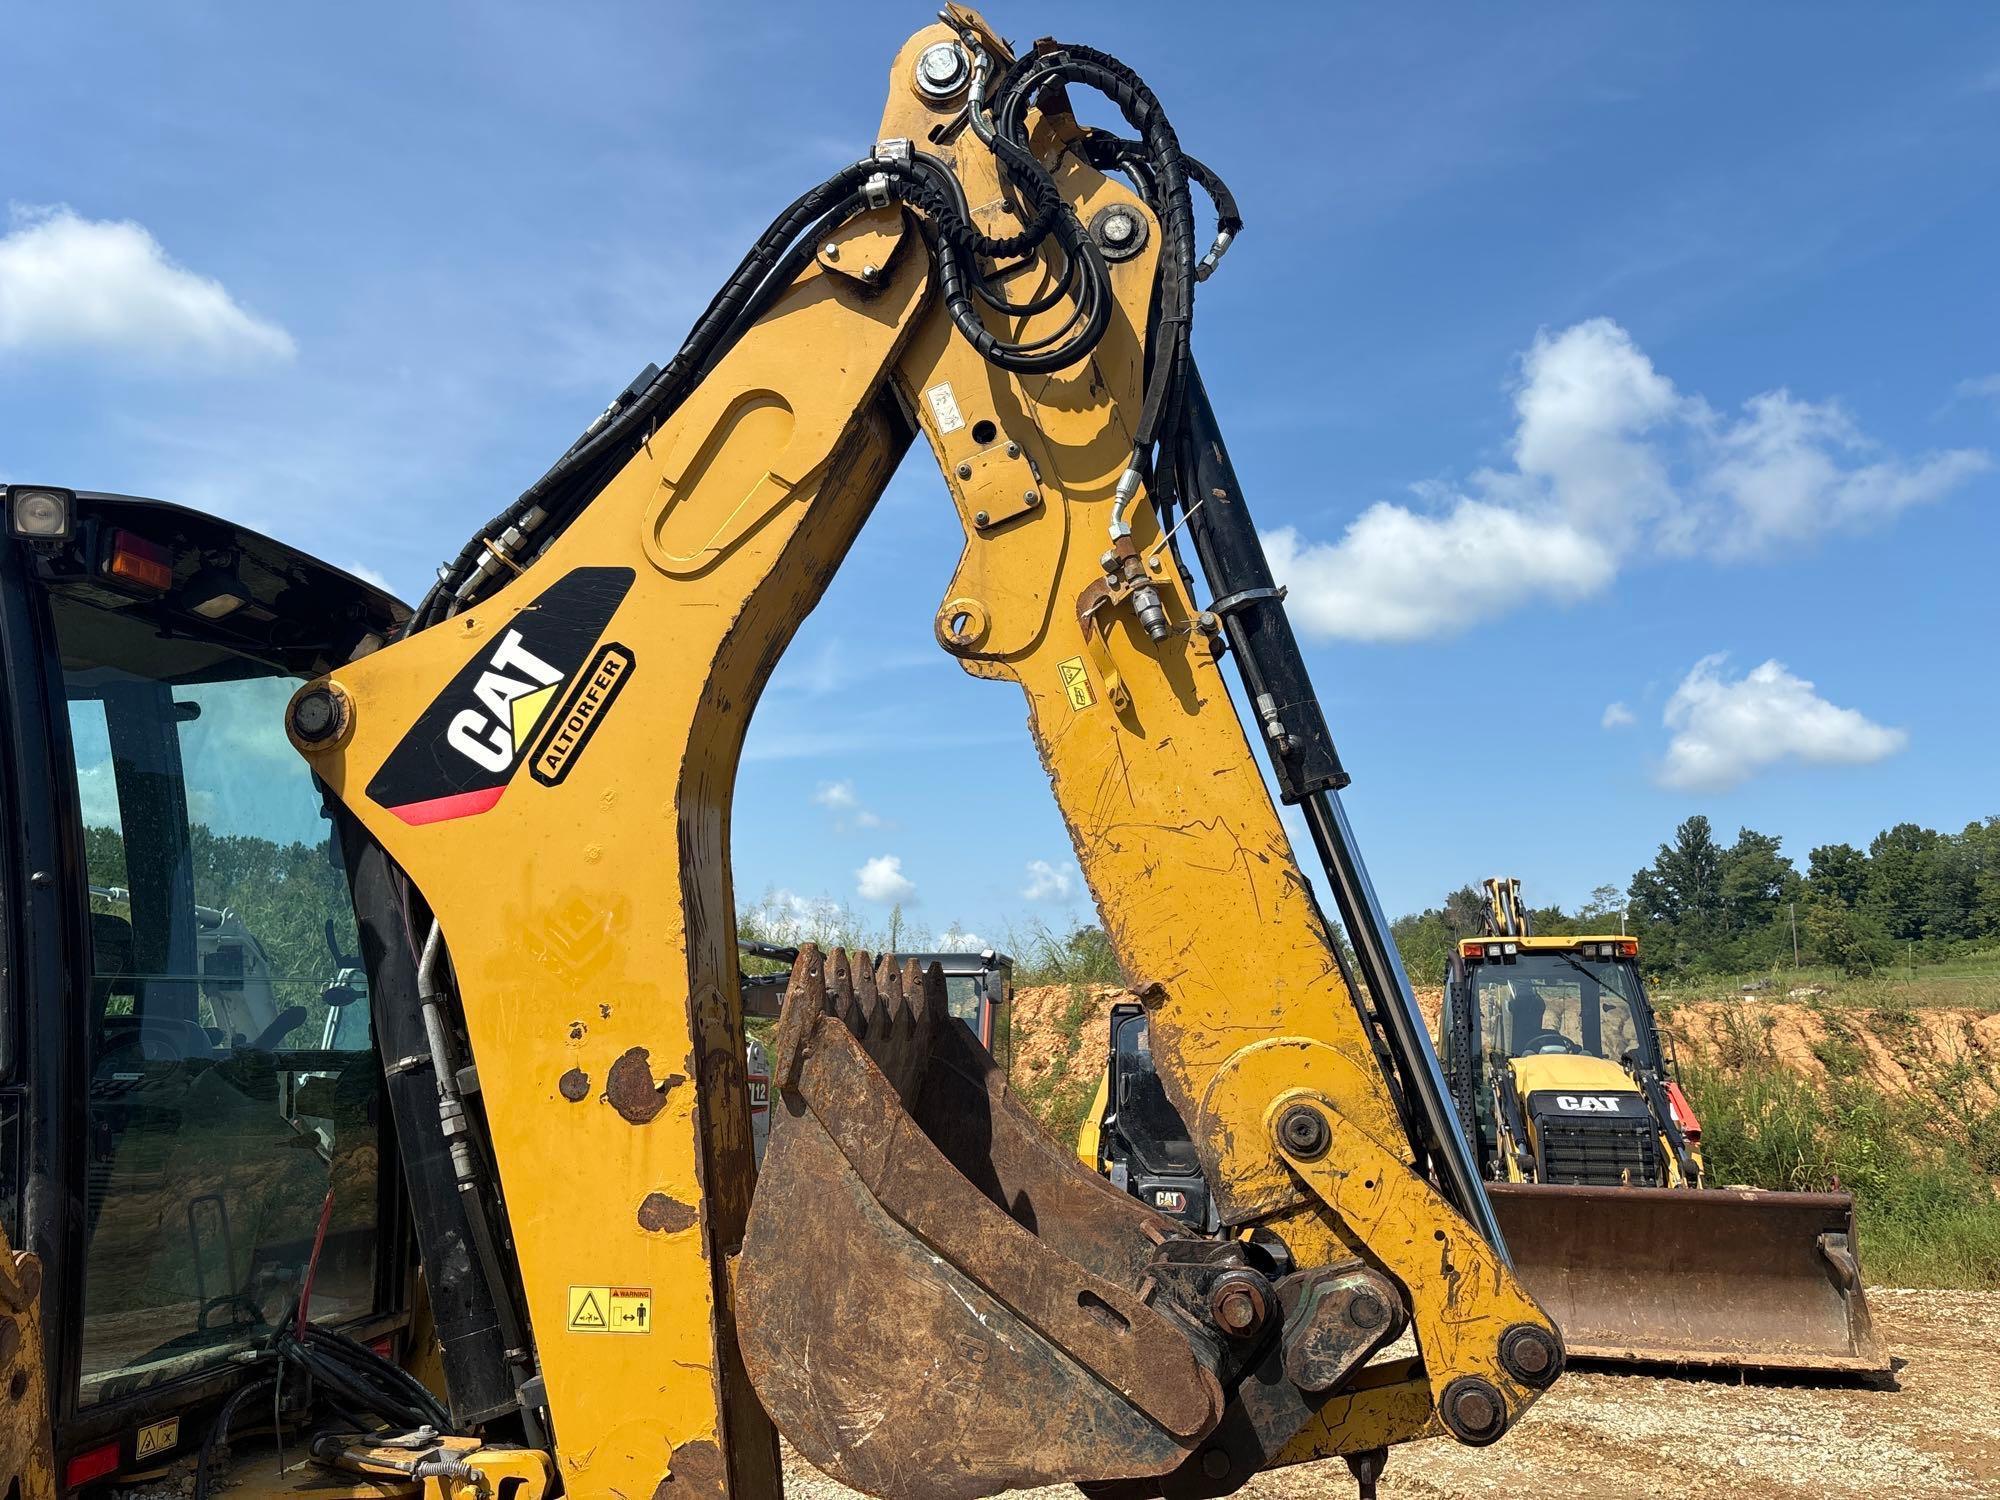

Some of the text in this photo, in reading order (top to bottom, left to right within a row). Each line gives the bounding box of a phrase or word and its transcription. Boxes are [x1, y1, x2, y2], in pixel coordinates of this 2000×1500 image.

[447, 628, 565, 772] CAT
[546, 660, 620, 770] ALTORFER
[1556, 1096, 1620, 1111] CAT
[1156, 1191, 1179, 1206] CAT
